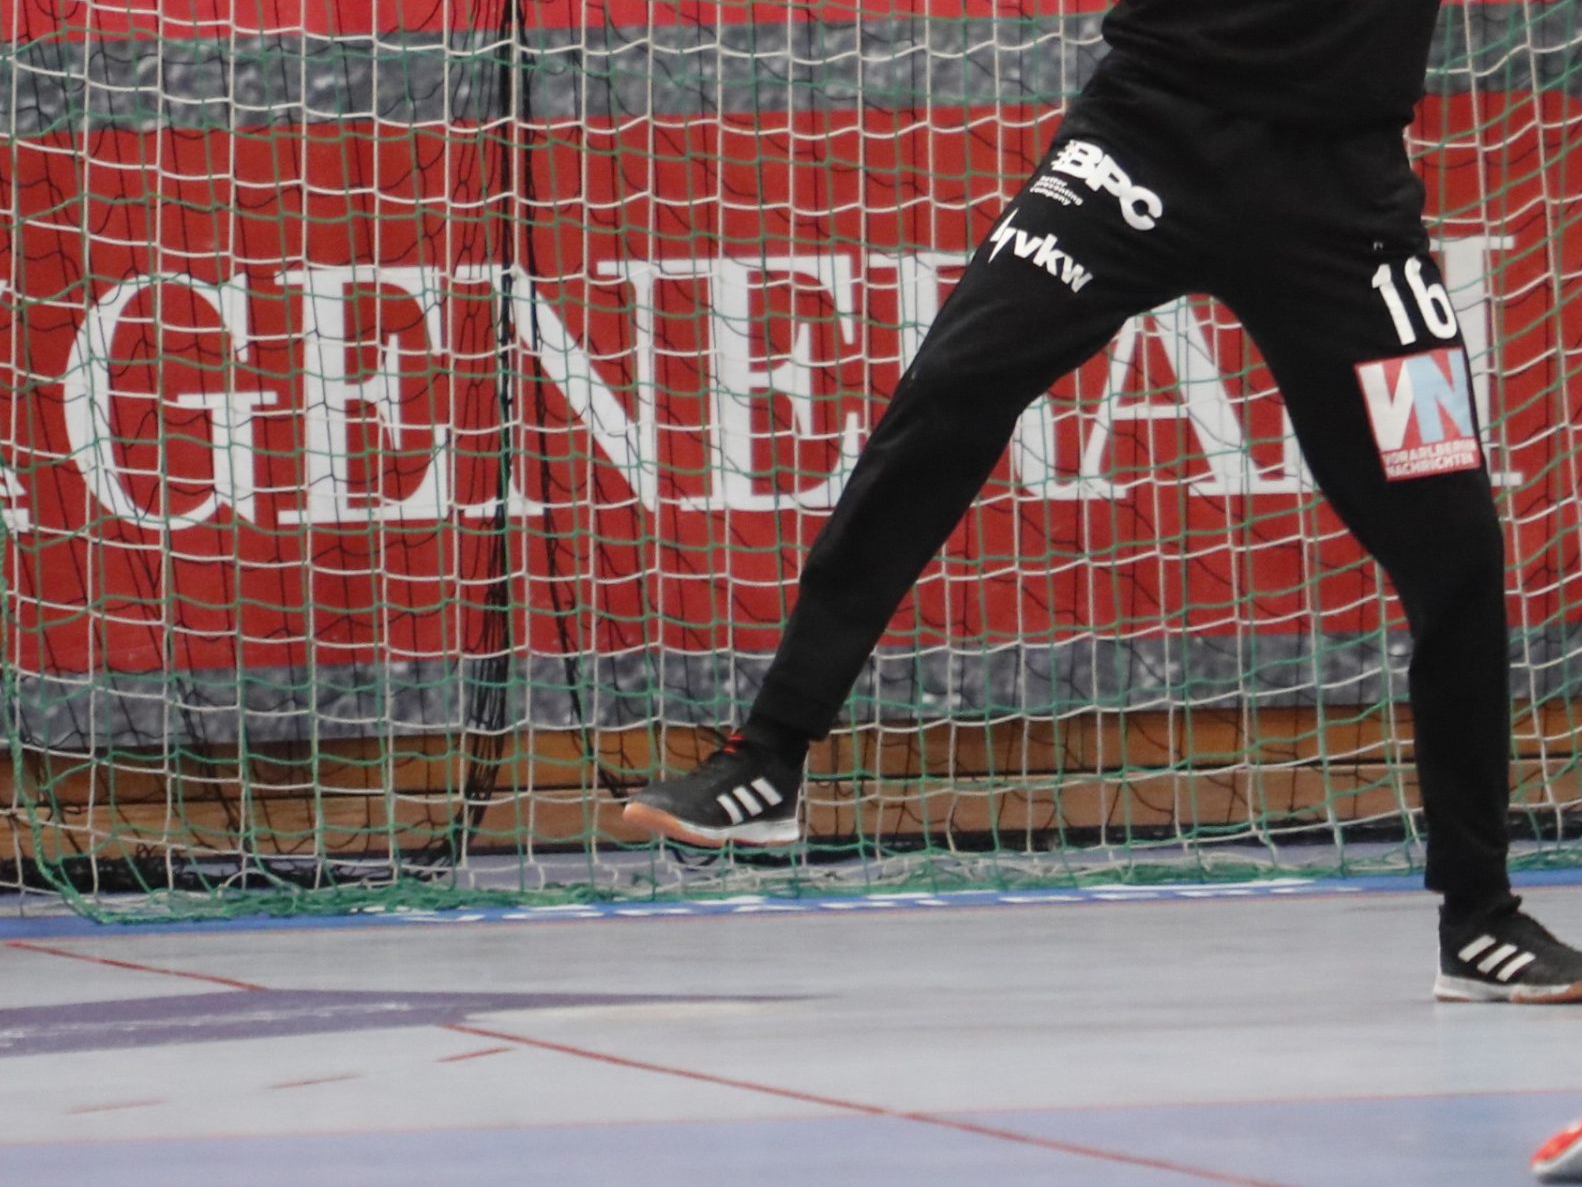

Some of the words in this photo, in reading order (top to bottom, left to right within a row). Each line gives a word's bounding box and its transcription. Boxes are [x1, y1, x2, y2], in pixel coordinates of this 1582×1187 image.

[1014, 232, 1094, 293] vkw
[1371, 256, 1458, 346] 16
[63, 236, 1524, 530] GENEAI
[1358, 348, 1474, 452] VN
